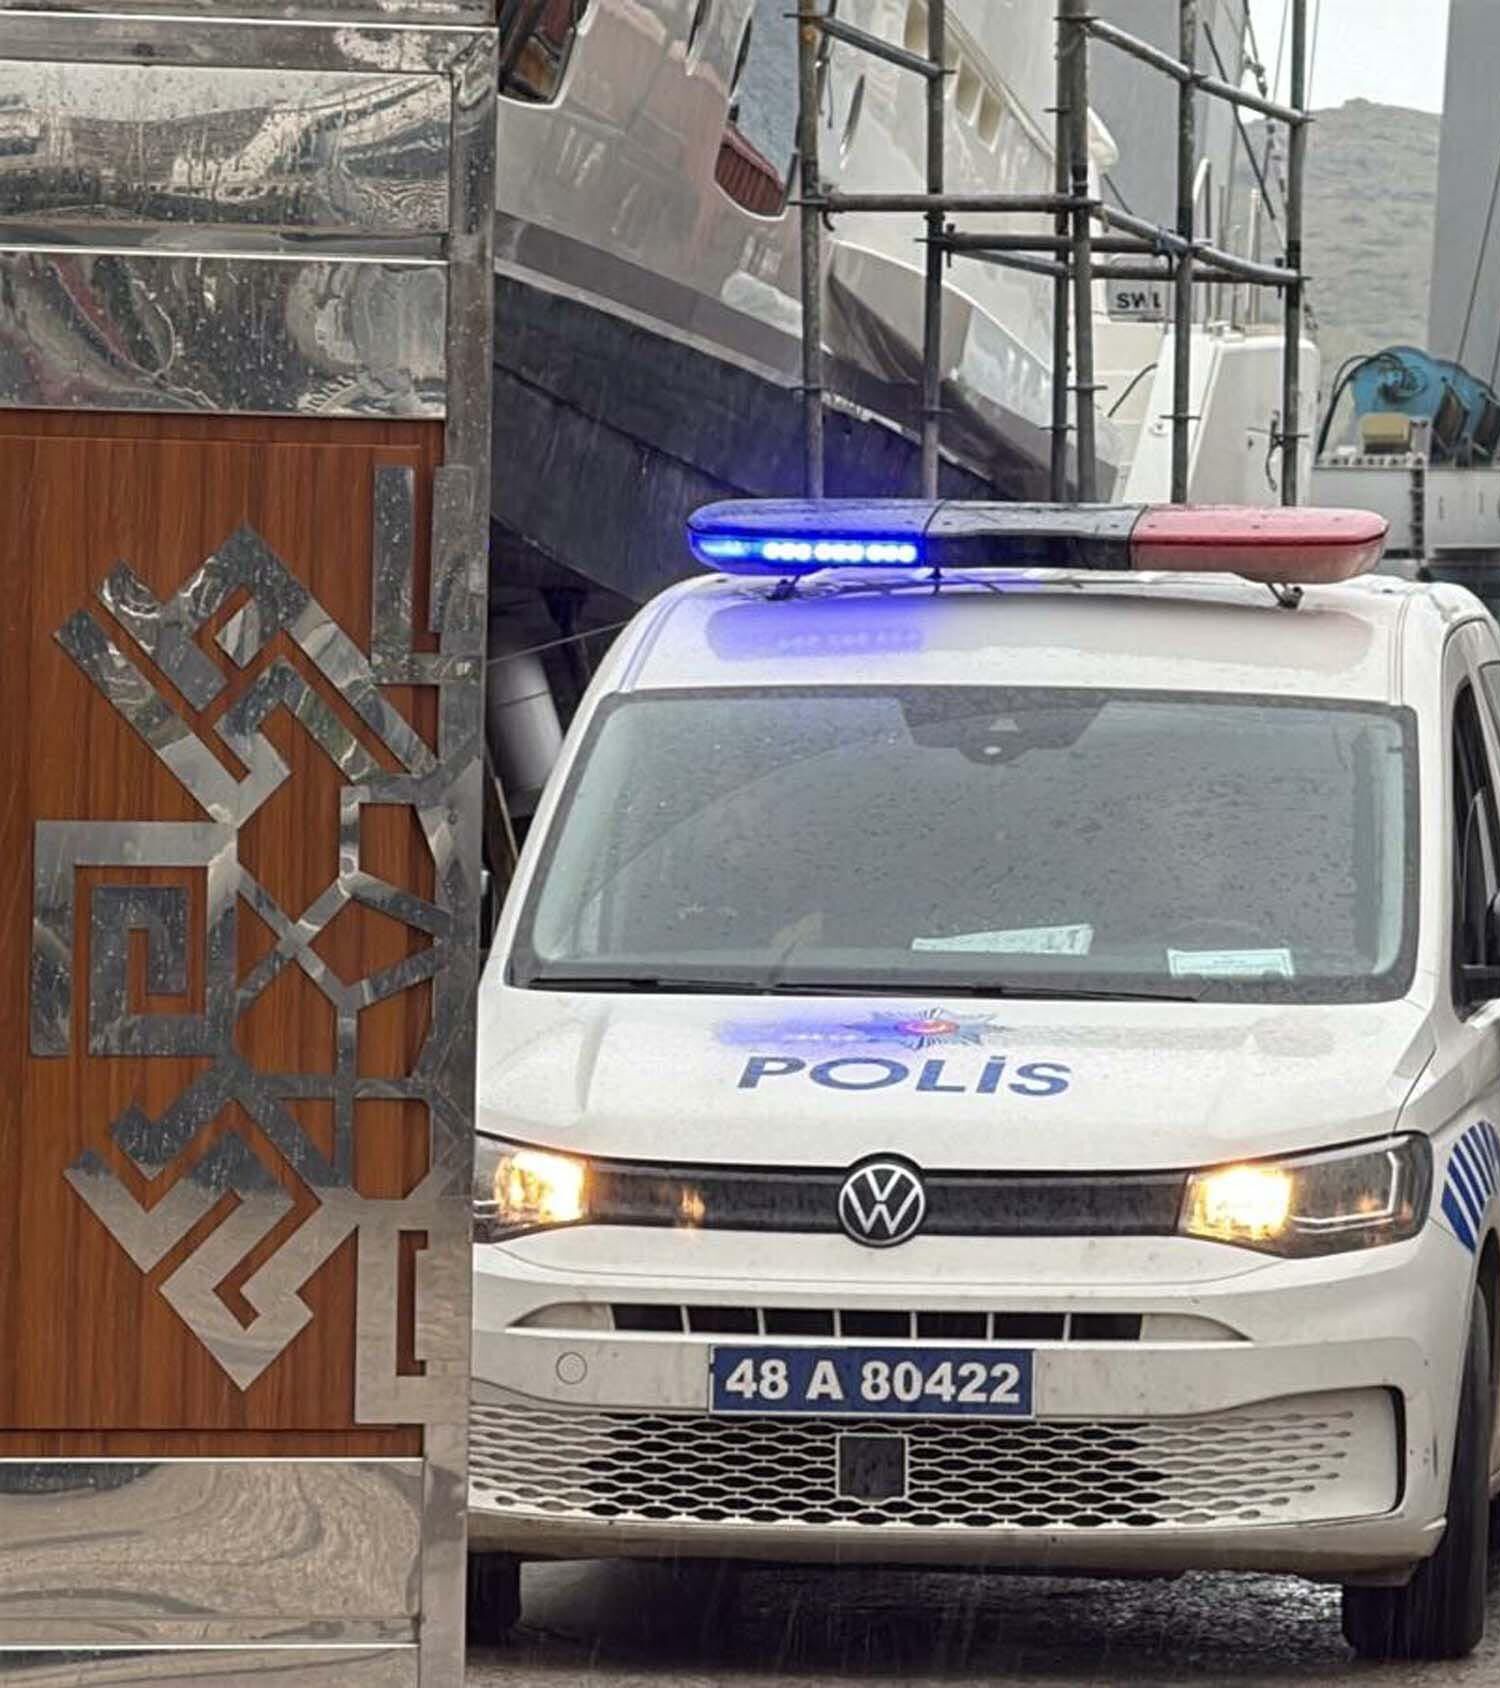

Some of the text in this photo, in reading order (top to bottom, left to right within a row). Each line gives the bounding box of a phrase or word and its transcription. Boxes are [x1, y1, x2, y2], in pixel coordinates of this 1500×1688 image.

[736, 1055, 1073, 1097] POLİS
[842, 1166, 924, 1243] VW
[726, 1358, 1021, 1404] 48 A 80422
